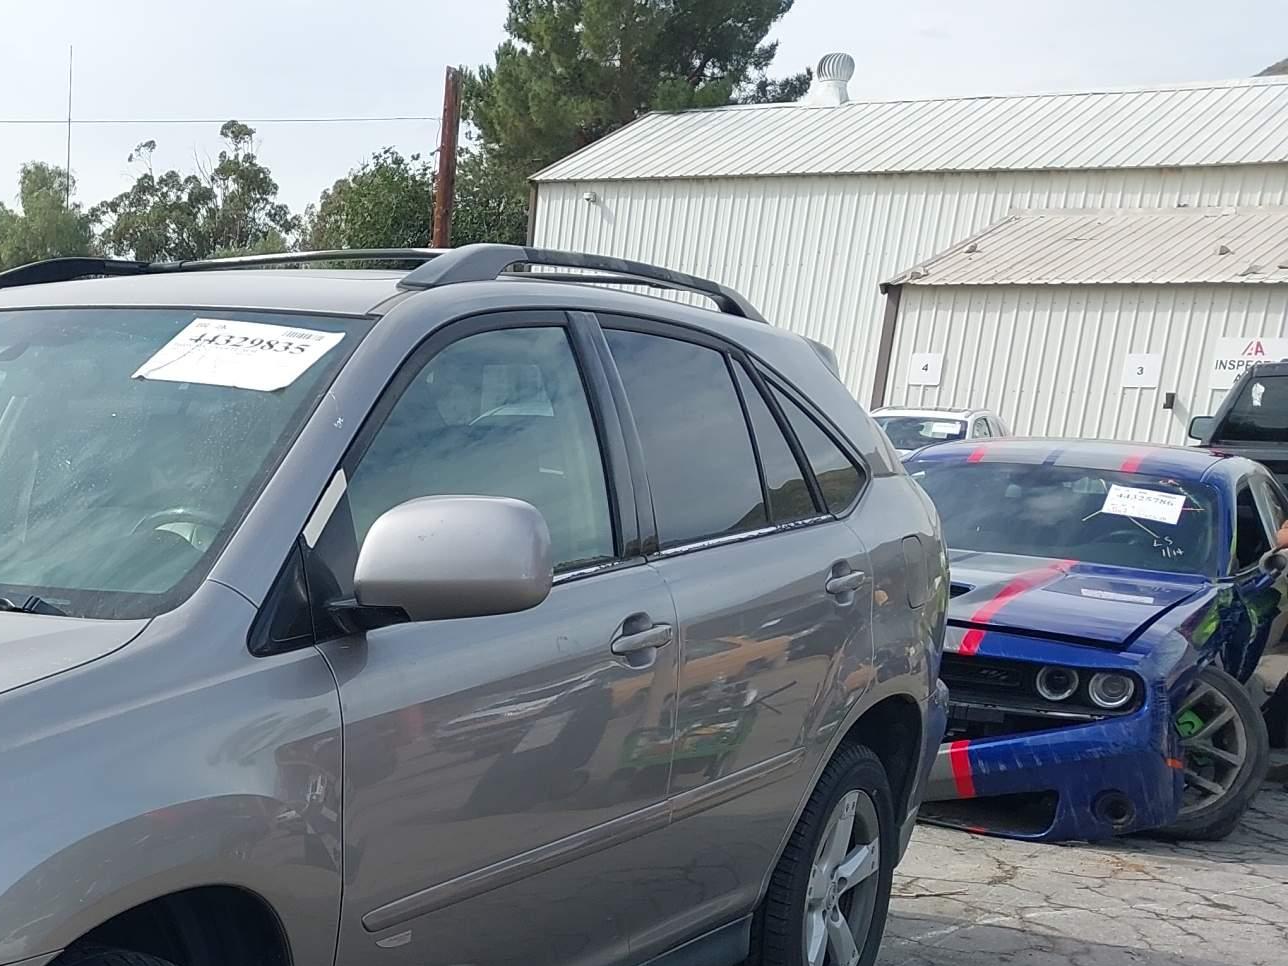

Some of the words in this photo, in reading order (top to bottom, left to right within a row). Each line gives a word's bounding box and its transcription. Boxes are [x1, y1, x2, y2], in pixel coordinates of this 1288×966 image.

[189, 333, 310, 354] 44329835
[921, 363, 929, 373] 4
[1137, 366, 1145, 376] 3
